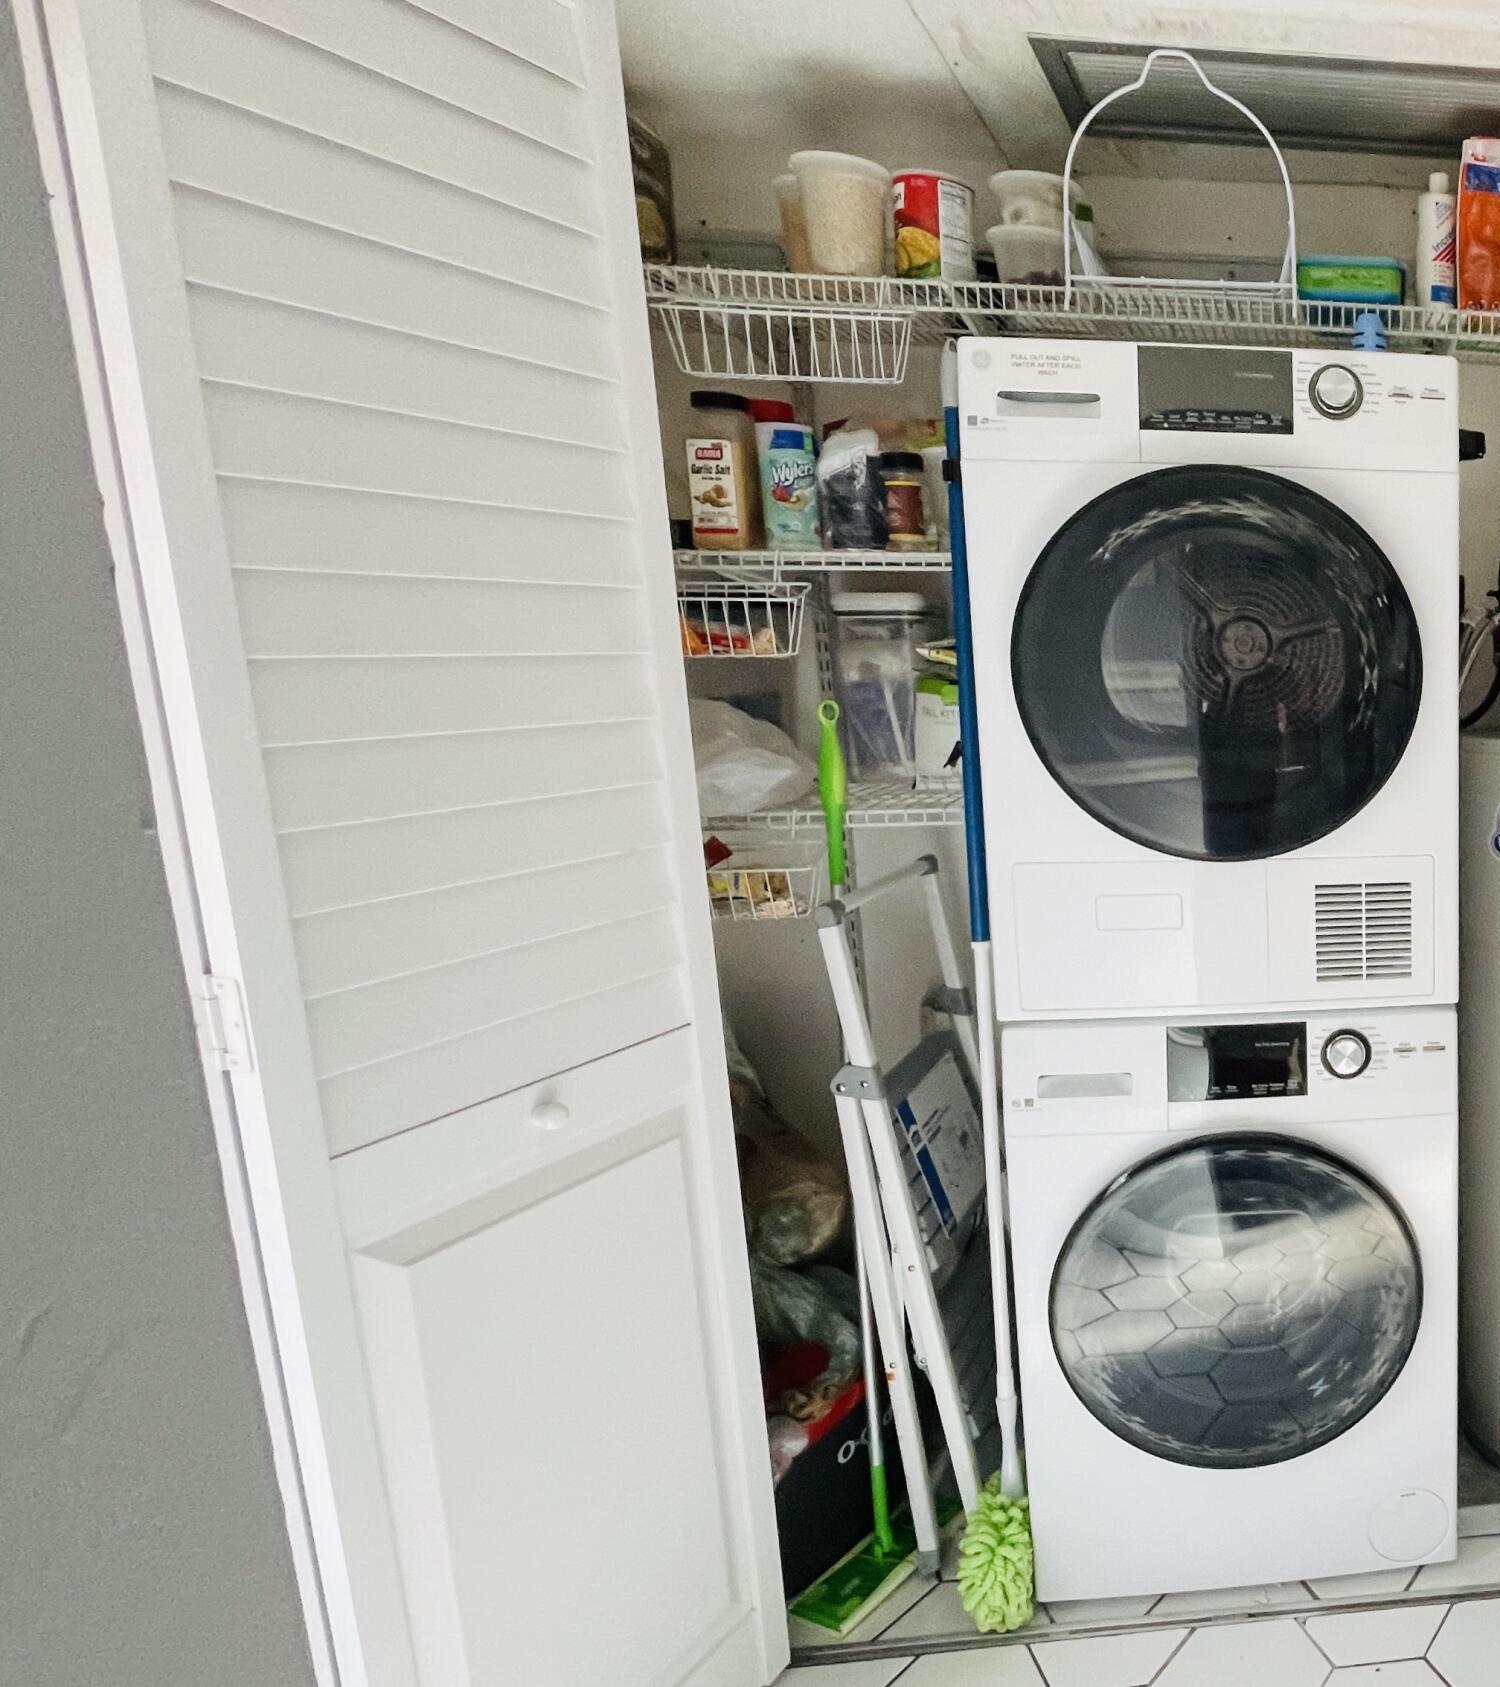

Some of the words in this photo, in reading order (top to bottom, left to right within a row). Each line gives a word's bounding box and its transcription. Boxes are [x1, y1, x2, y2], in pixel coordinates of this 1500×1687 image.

[1011, 353, 1027, 361] PULL
[1037, 361, 1060, 369] AFTER
[691, 463, 713, 474] Garlic
[715, 464, 731, 475] Salt
